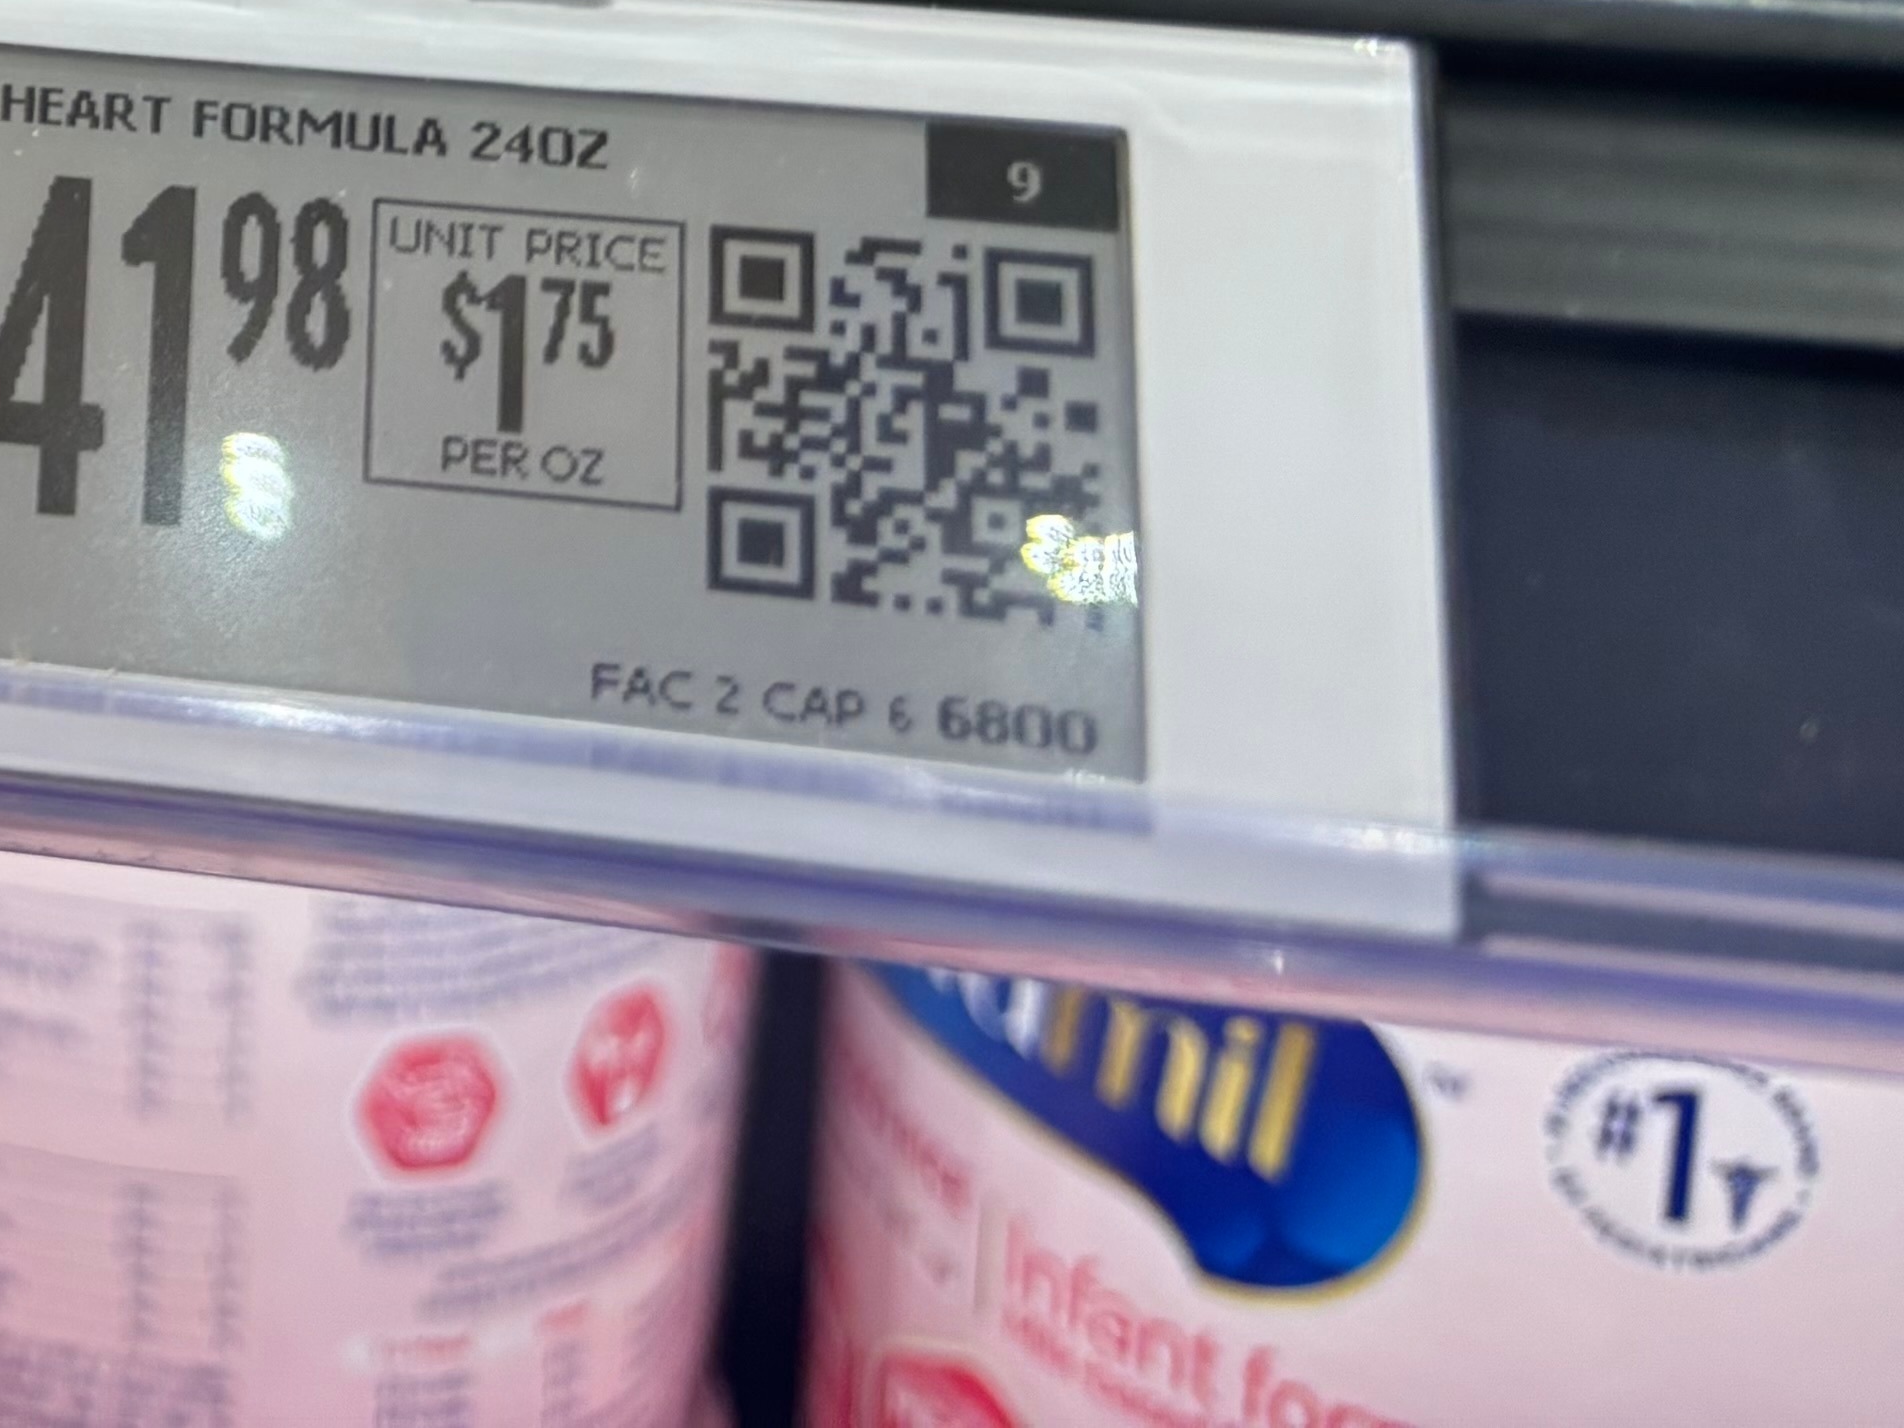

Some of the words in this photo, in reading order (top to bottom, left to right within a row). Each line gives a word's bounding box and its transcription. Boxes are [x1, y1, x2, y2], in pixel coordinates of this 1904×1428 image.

[192, 99, 448, 158] FORMULA
[1006, 160, 1042, 204] 9
[389, 215, 505, 261] UNIT
[525, 227, 667, 275] PRICE
[441, 435, 530, 481] PER
[539, 445, 604, 486] OZ
[591, 661, 694, 712] FAC
[714, 674, 742, 716] 2
[761, 680, 866, 727] CAP
[935, 693, 1101, 756] 6800
